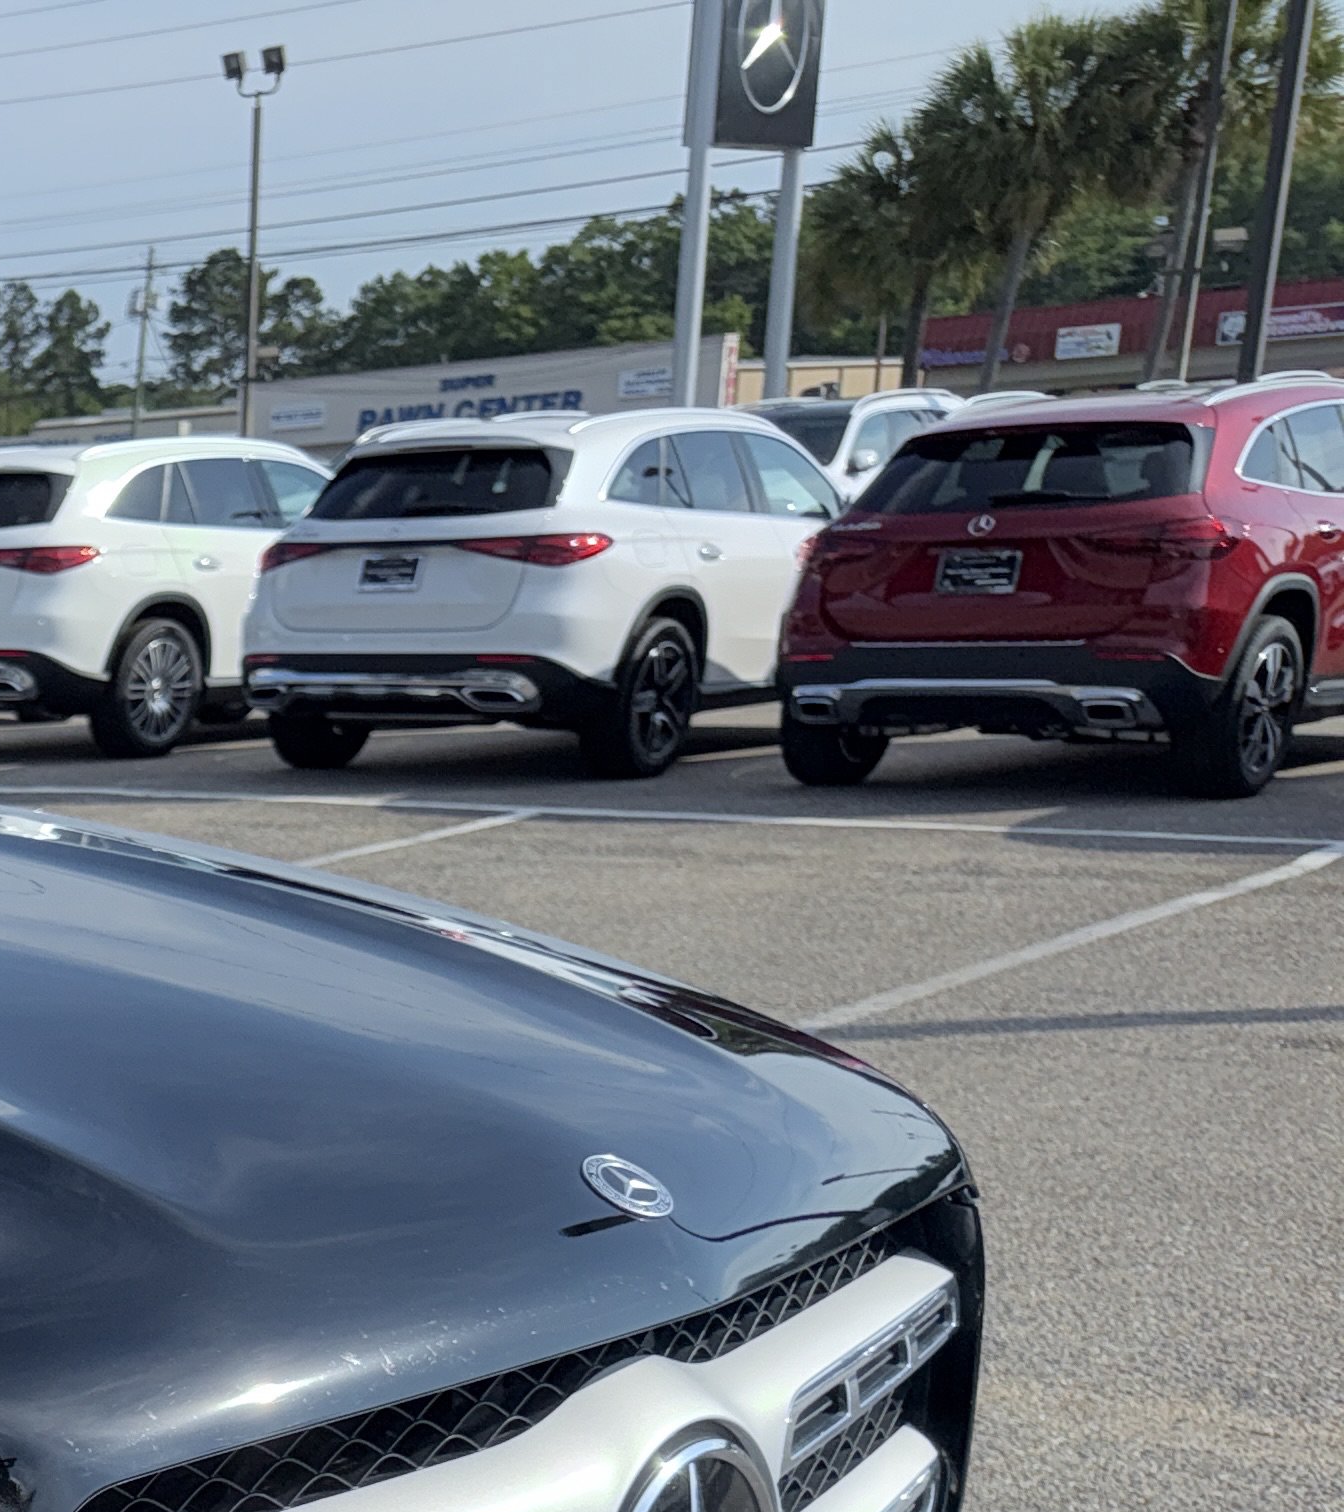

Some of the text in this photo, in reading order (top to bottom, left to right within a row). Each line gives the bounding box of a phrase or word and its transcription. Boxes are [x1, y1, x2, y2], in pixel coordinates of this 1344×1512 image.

[439, 374, 495, 392] SUPER
[357, 390, 583, 434] PAWN CENTER
